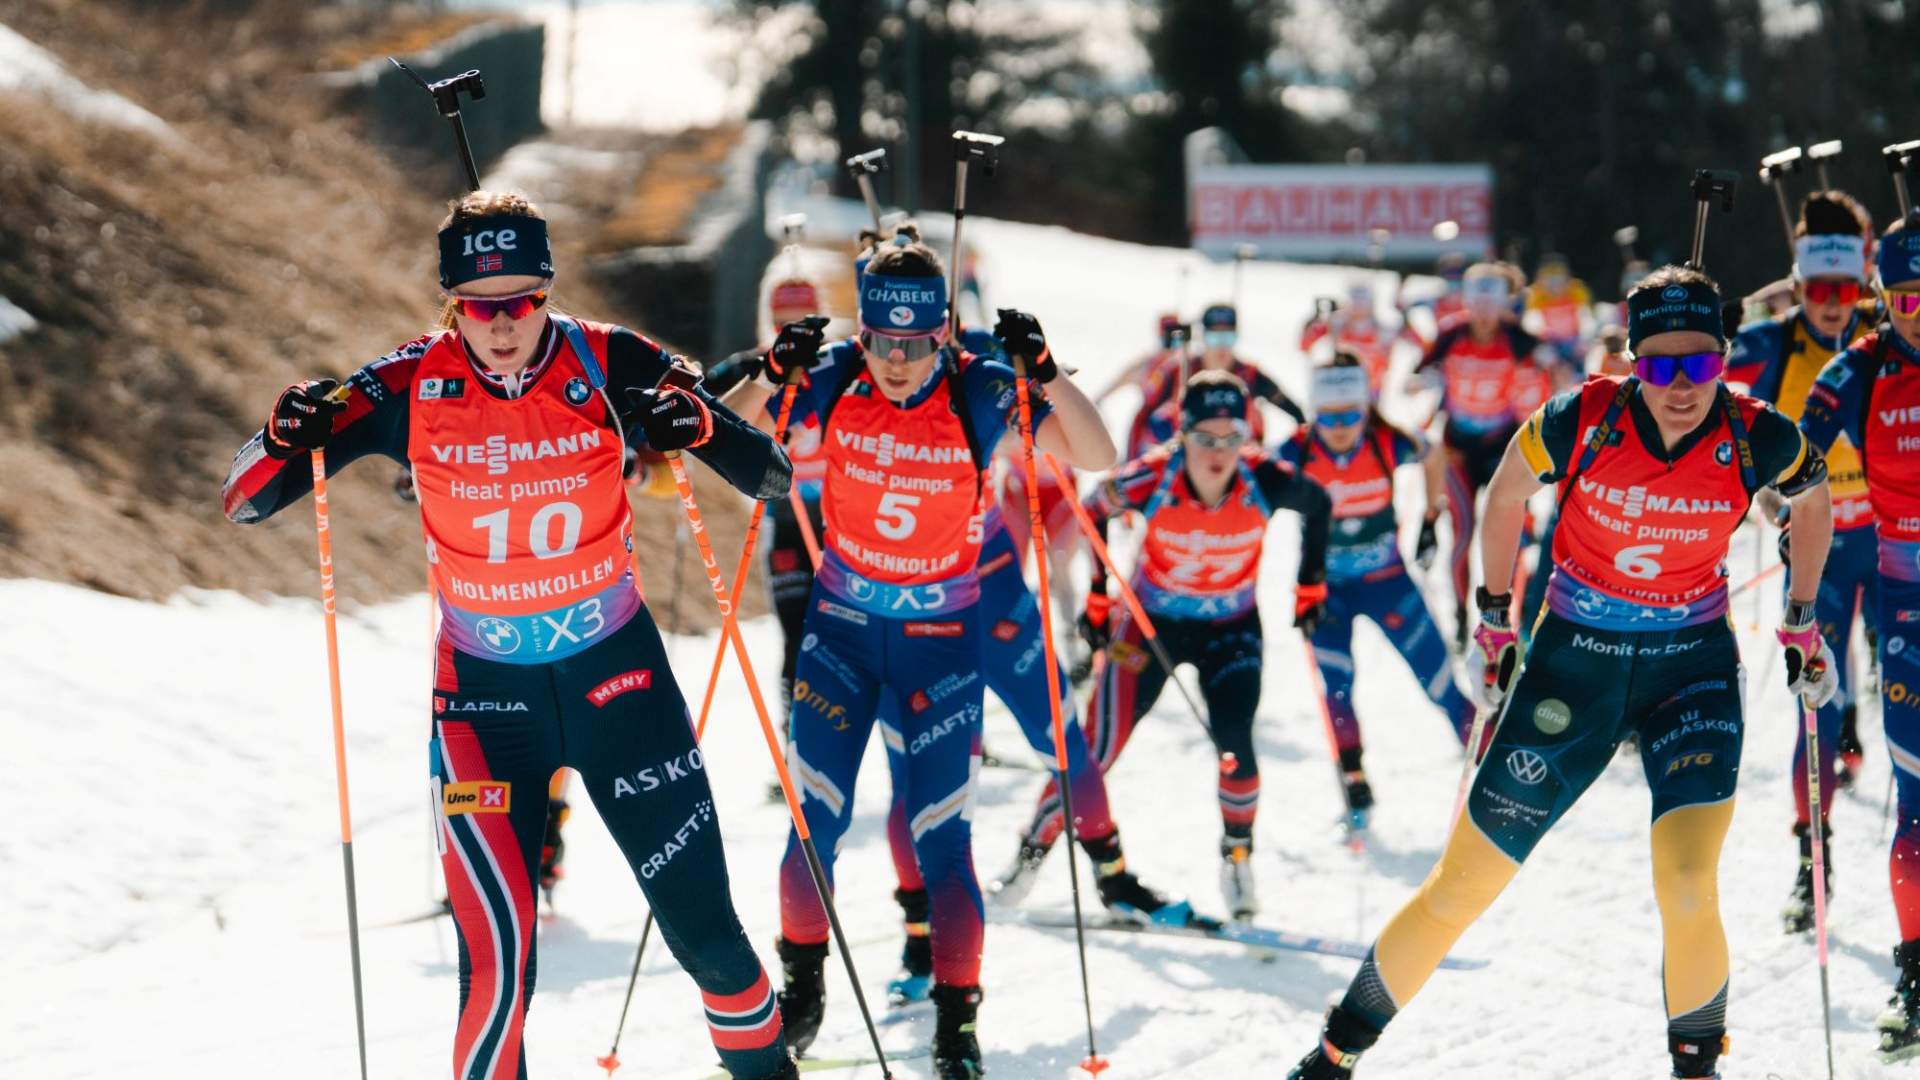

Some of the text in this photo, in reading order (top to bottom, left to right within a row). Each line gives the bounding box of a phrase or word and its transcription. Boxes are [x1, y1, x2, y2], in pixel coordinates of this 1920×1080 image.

[1194, 184, 1487, 236] BAUHAUS
[867, 288, 936, 304] CHABERT
[430, 429, 601, 475] VIESSMANN
[835, 428, 972, 467] VIESSMANN
[450, 472, 588, 502] Heat pumps
[844, 461, 954, 496] Heat pumps
[1578, 475, 1732, 518] VIESSMANN
[472, 501, 583, 564] 10
[874, 491, 921, 541] 5
[965, 513, 985, 544] 5
[1586, 505, 1710, 545] Heat pumps
[451, 556, 613, 601] HOLMENKOLLEN
[1614, 543, 1664, 580] 6
[541, 598, 605, 652] X3
[594, 673, 647, 700] MENY
[450, 701, 529, 712] LAPUA
[1536, 706, 1567, 726] dina
[910, 709, 967, 755] CRAFT
[1652, 719, 1738, 752] SVEASKOG
[1665, 752, 1713, 776] ATG
[447, 787, 504, 806] Uno X
[640, 813, 701, 879] CRAFT
